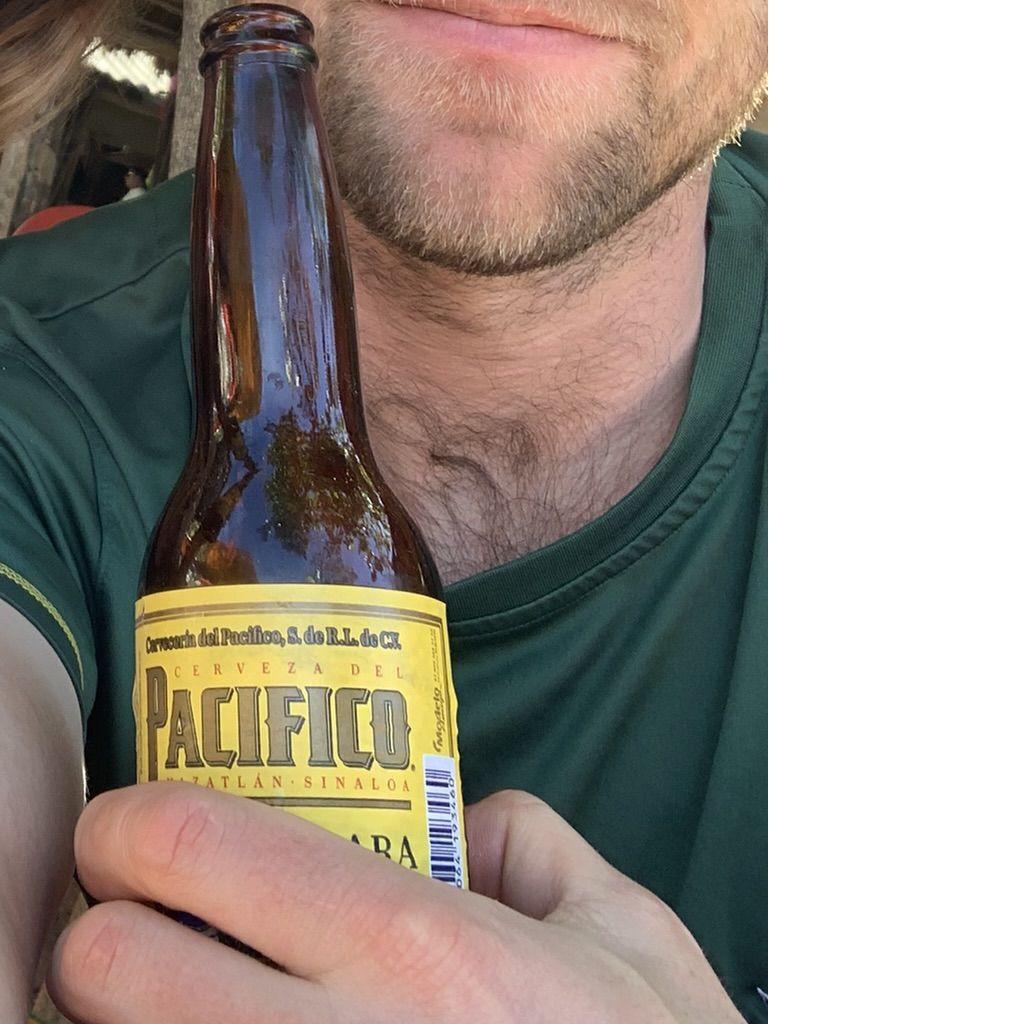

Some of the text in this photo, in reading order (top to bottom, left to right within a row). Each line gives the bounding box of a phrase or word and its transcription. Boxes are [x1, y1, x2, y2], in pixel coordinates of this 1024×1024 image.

[198, 626, 219, 647] del
[287, 626, 302, 645] S.
[303, 625, 324, 645] de
[325, 627, 359, 646] R.L.
[359, 628, 378, 648] de
[174, 662, 403, 679] CERVEZA DEL
[146, 666, 411, 782] PACIFICO
[166, 775, 411, 792] ZATLÁN SINALOA
